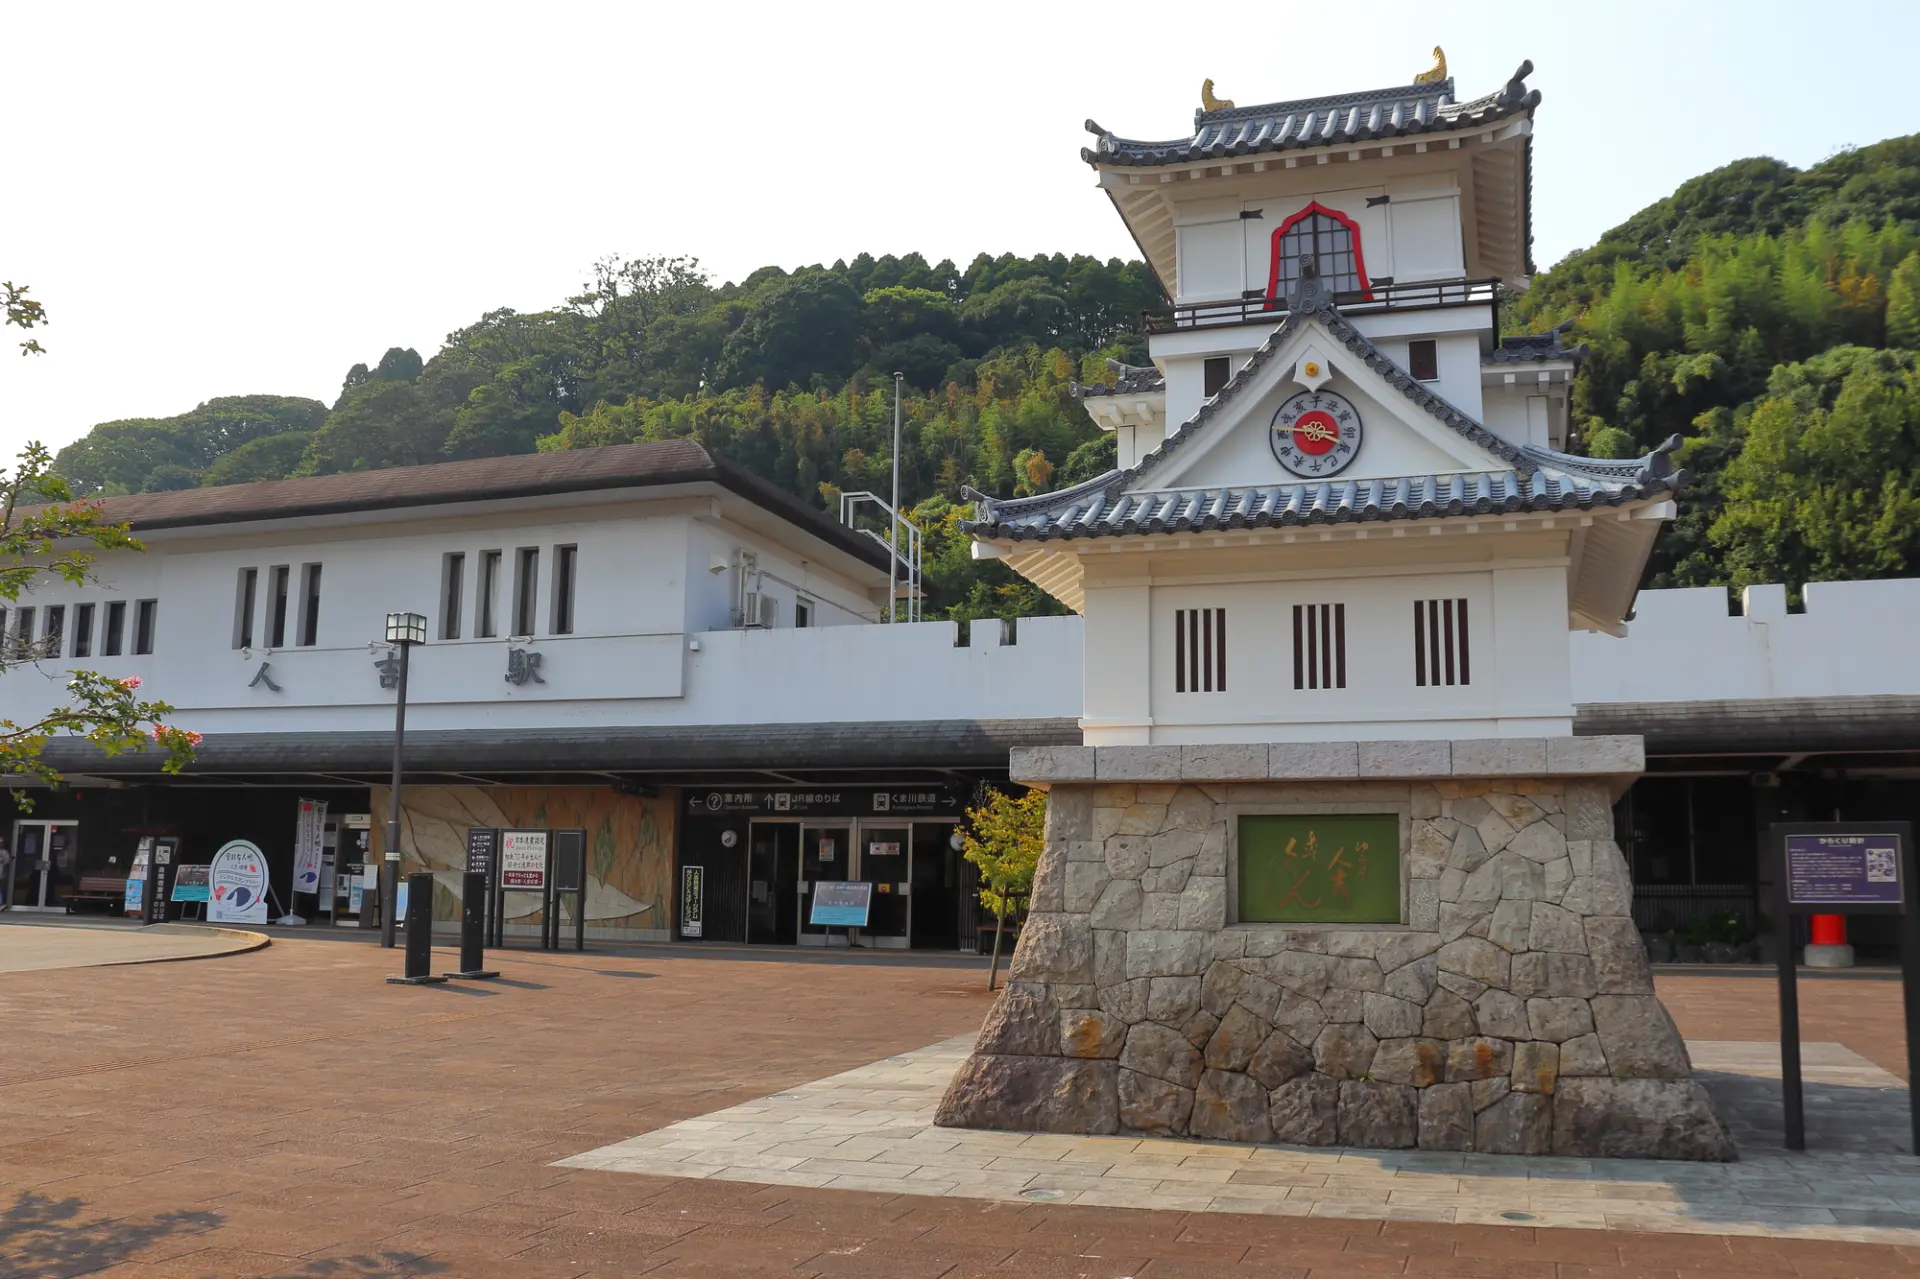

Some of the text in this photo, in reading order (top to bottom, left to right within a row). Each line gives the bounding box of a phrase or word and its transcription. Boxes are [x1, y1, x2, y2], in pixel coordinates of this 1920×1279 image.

[1310, 396, 1322, 408] 子
[1326, 400, 1339, 412] 丑
[1337, 410, 1351, 424] 寅
[1343, 427, 1356, 438] 卯
[1336, 441, 1351, 454] 辰
[1309, 459, 1322, 472] 午
[248, 648, 545, 692] 人吉駅
[724, 793, 753, 803] 案内所
[791, 793, 841, 803] JR線のりば
[892, 793, 936, 803] くま川鉄道
[1819, 837, 1864, 845] からくり時計
